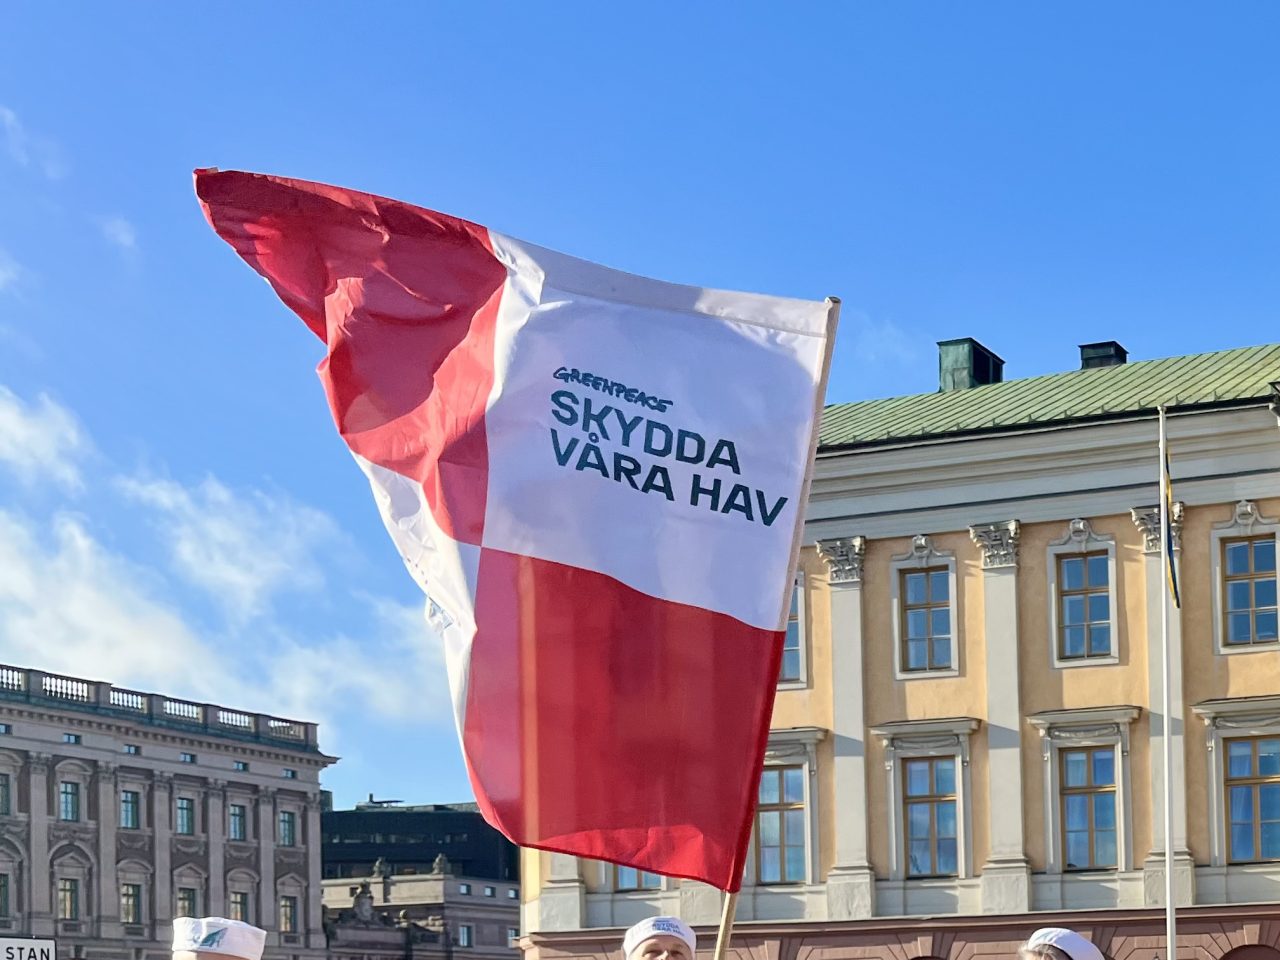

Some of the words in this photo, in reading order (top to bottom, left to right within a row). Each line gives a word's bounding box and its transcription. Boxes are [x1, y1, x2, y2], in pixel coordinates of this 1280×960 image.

[552, 366, 674, 413] GREENPEACE
[550, 390, 741, 475] SKYDDA
[550, 428, 675, 502] VÅRA
[689, 473, 789, 527] HAV
